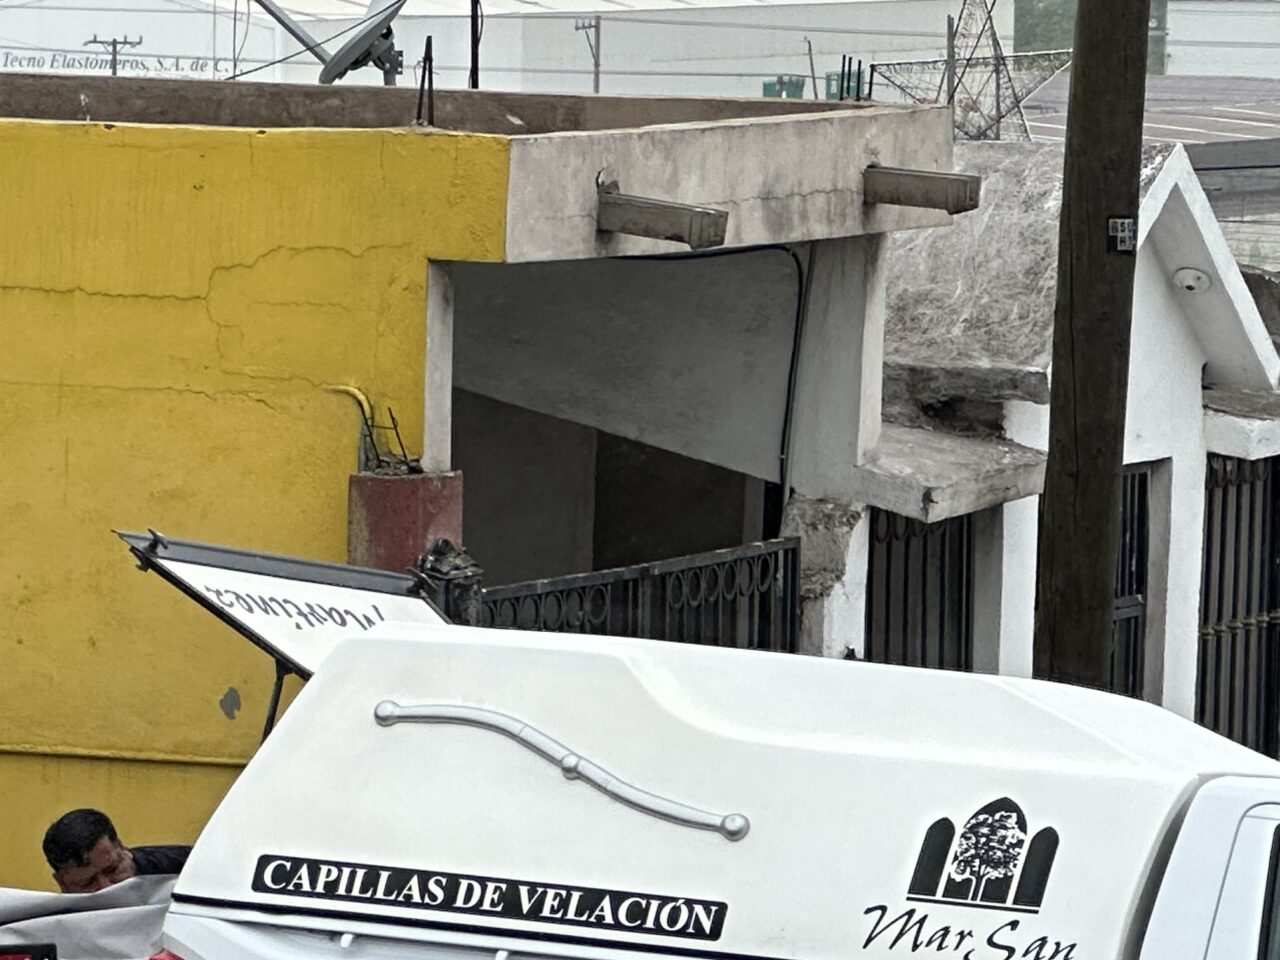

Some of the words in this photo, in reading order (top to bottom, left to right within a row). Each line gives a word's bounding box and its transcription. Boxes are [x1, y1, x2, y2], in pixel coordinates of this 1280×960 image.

[2, 51, 46, 69] Tecno
[190, 57, 209, 73] de
[261, 858, 448, 906] CAPILLAS
[454, 878, 507, 912] DE
[517, 884, 719, 936] VELACIÓN
